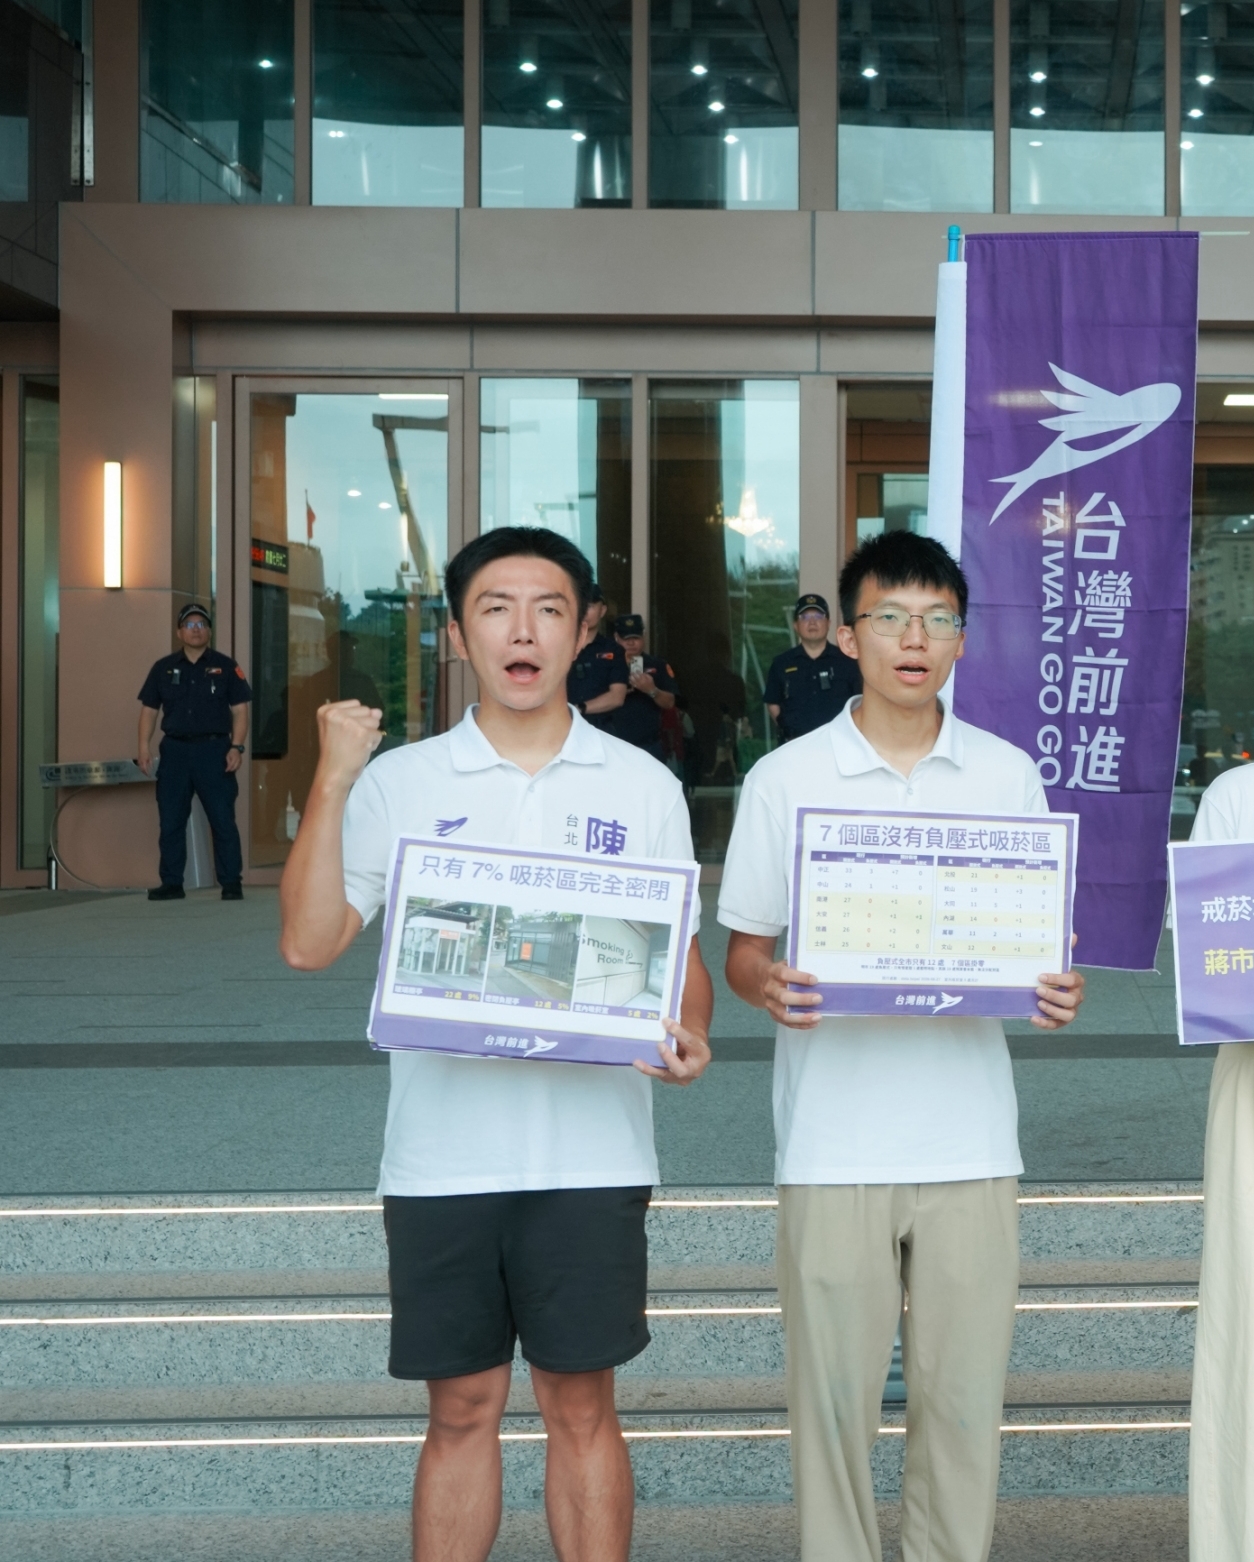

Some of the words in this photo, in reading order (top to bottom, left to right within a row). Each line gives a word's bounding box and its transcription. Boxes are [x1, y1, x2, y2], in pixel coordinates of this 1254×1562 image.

[1042, 492, 1064, 642] TAIWAN
[1066, 492, 1133, 792] 台灣前進
[1038, 653, 1063, 715] GO
[1037, 724, 1062, 786] GO
[564, 814, 579, 846] 台北
[586, 817, 627, 856] 陳
[820, 825, 831, 841] 7
[838, 824, 1051, 853] 個區沒有負壓式吸菸區
[419, 855, 466, 878] 只有
[471, 861, 504, 881] 7%
[510, 866, 670, 901] 吸菸區完全密閉
[597, 953, 624, 965] Room
[895, 995, 936, 1006] 台灣前進
[484, 1035, 530, 1049] 台灣前進
